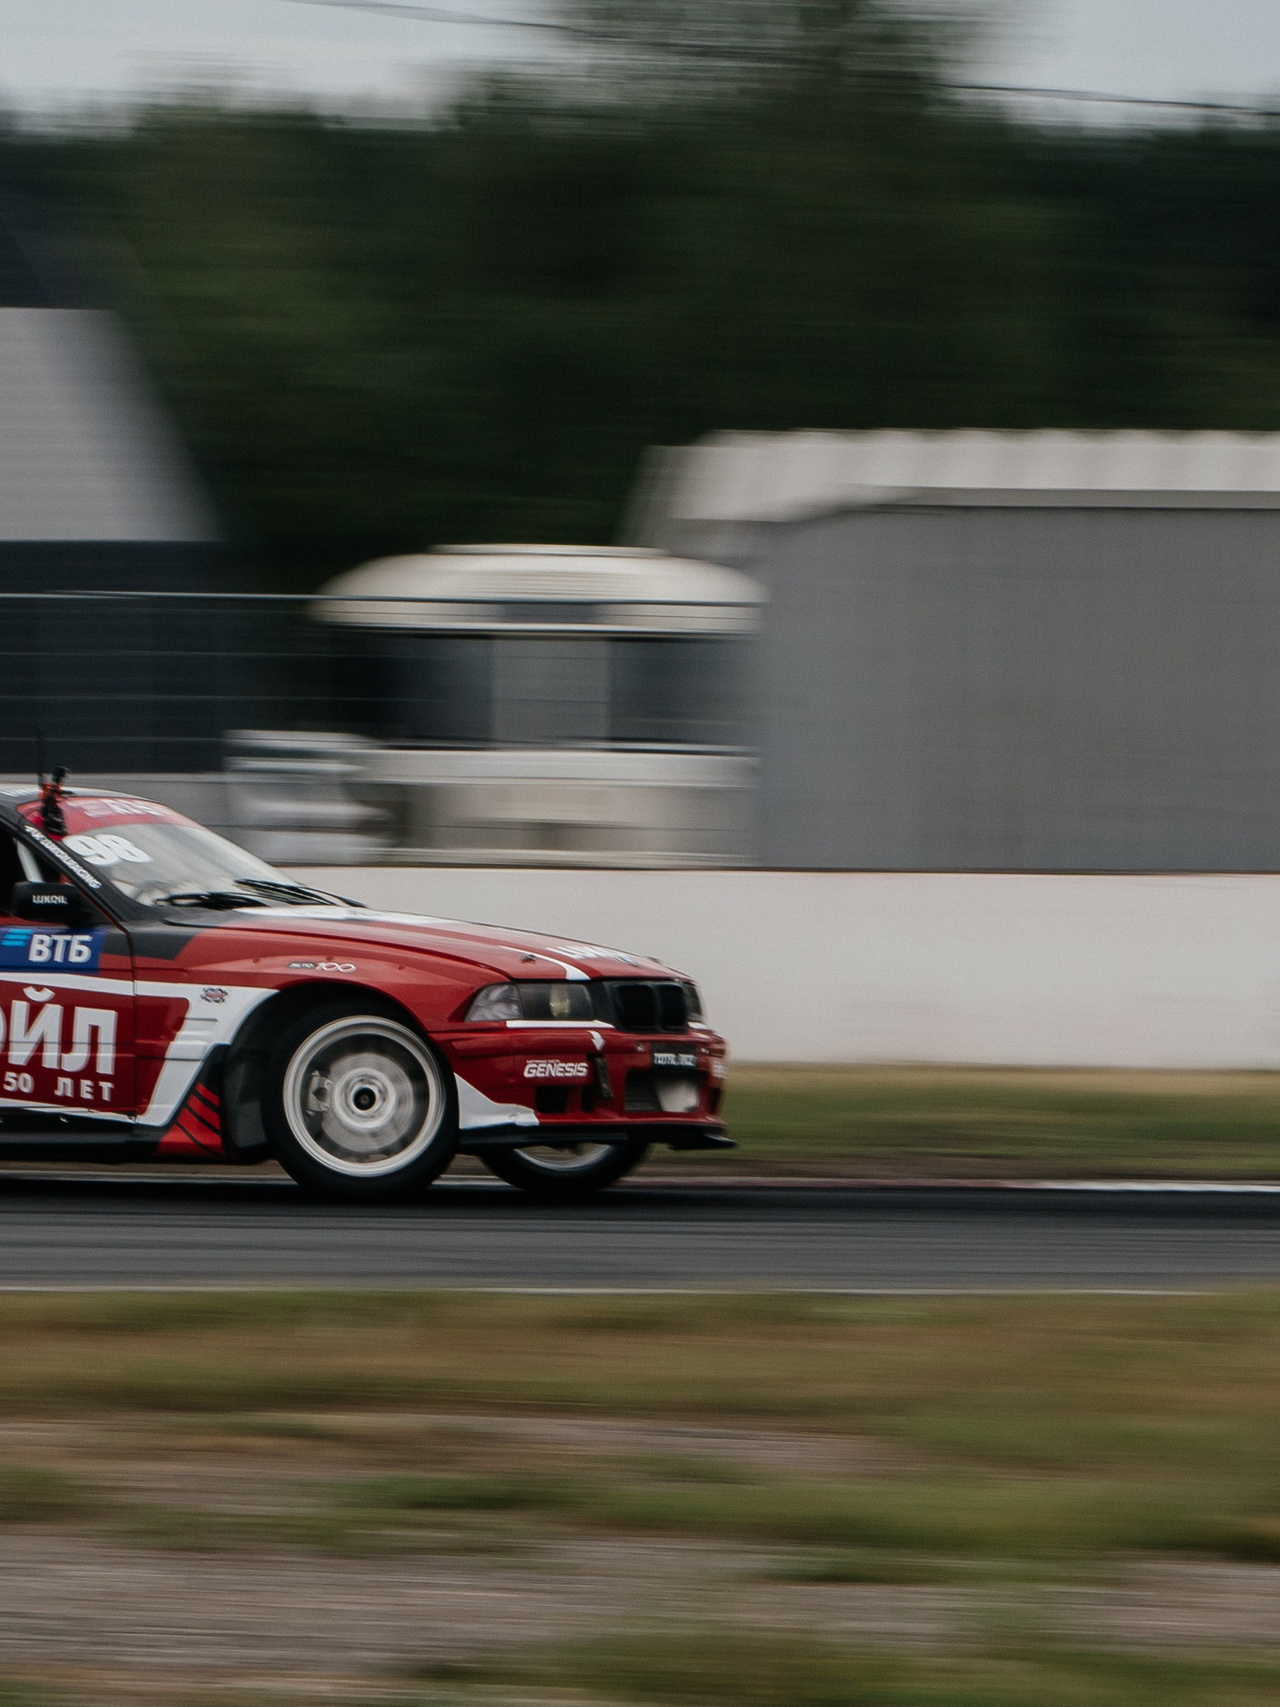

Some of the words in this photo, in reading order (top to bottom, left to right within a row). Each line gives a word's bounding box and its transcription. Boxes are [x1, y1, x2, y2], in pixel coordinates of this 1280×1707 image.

[62, 834, 153, 866] 98
[32, 894, 68, 905] LUKOIL
[28, 934, 93, 963] ВТБ
[315, 961, 356, 973] 100
[523, 1062, 589, 1078] GENESIS
[3, 1071, 35, 1093] 50
[54, 1077, 115, 1101] ЛЕТ
